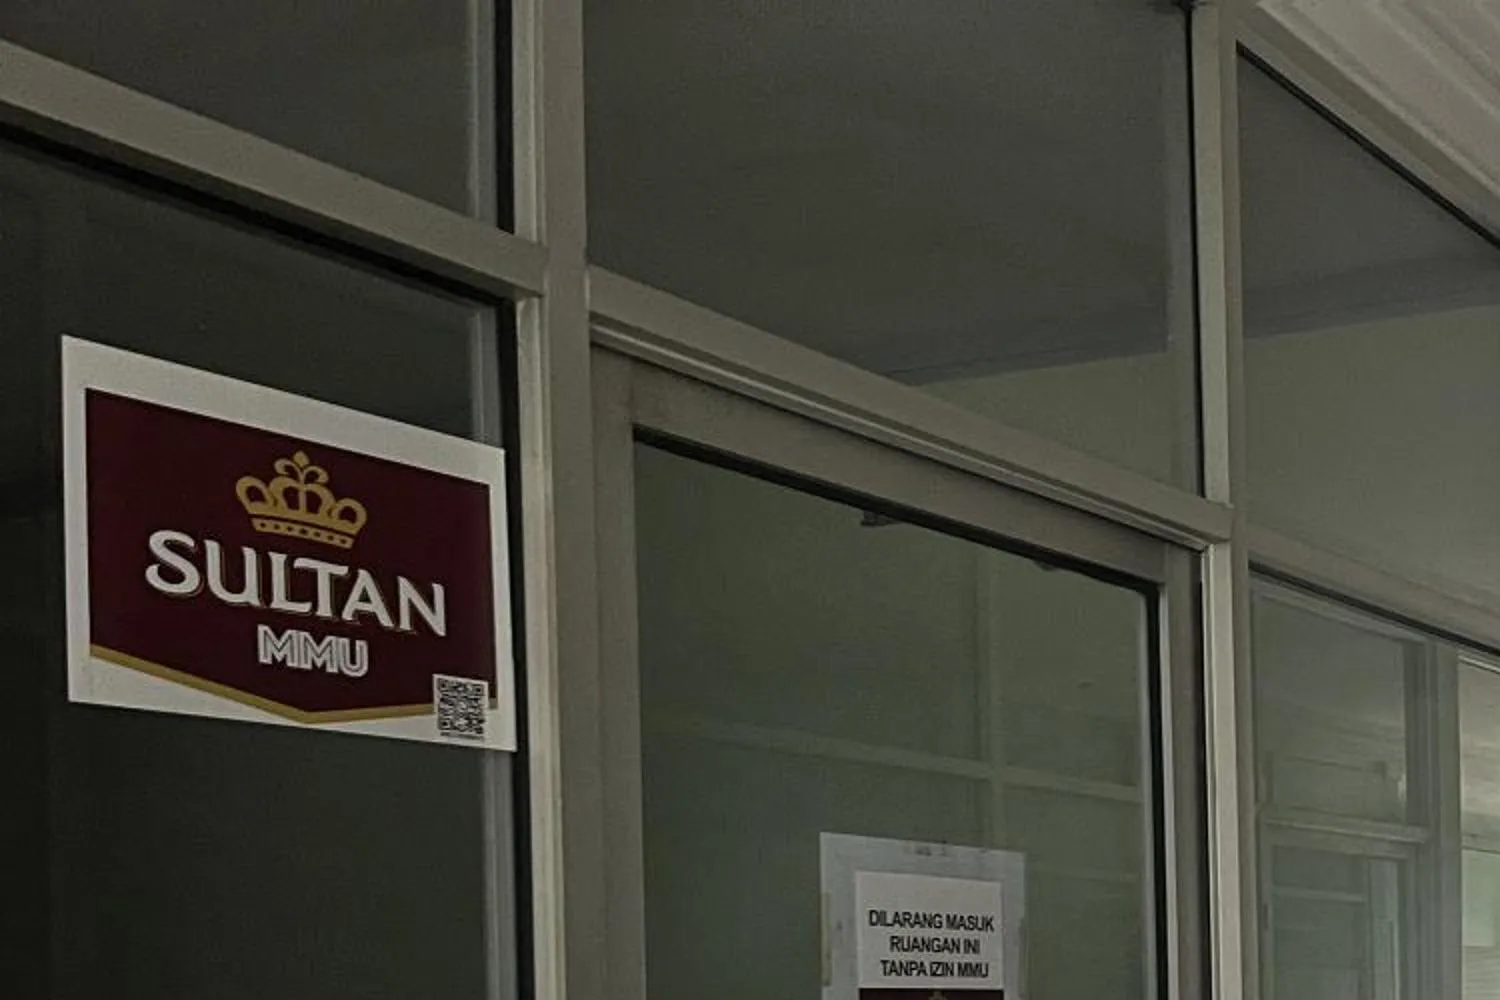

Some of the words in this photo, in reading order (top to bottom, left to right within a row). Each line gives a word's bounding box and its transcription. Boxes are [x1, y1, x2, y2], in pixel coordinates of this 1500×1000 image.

[145, 529, 446, 637] SULTAN
[257, 624, 368, 678] MMU
[869, 909, 943, 929] DILARANG
[945, 914, 995, 932] MASUK
[890, 935, 961, 954] RUANGAN
[963, 938, 980, 954] INI
[880, 959, 928, 977] TANPA
[930, 961, 954, 977] IZIN
[957, 962, 989, 978] MMU
